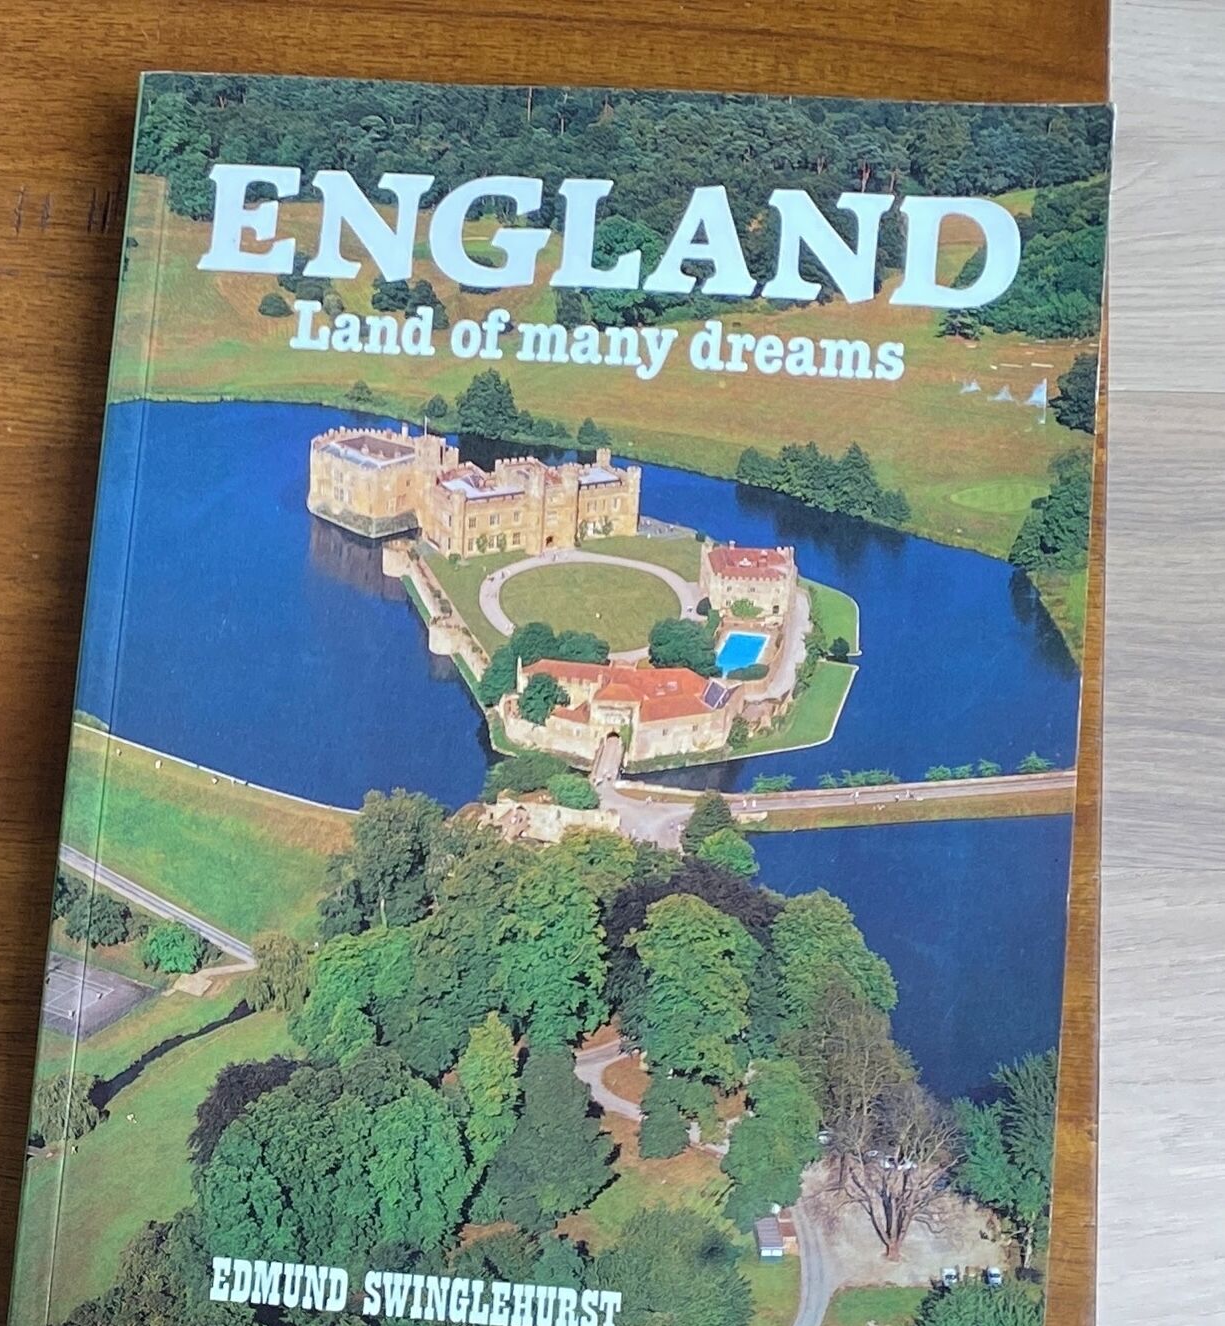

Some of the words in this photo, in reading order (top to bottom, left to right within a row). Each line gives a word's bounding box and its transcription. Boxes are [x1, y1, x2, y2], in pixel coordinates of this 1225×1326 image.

[197, 163, 1021, 310] ENGLAND
[290, 299, 436, 356] Land
[449, 309, 511, 360] of
[516, 322, 678, 380] many
[689, 320, 905, 381] dreams
[209, 1256, 349, 1312] EDMUND
